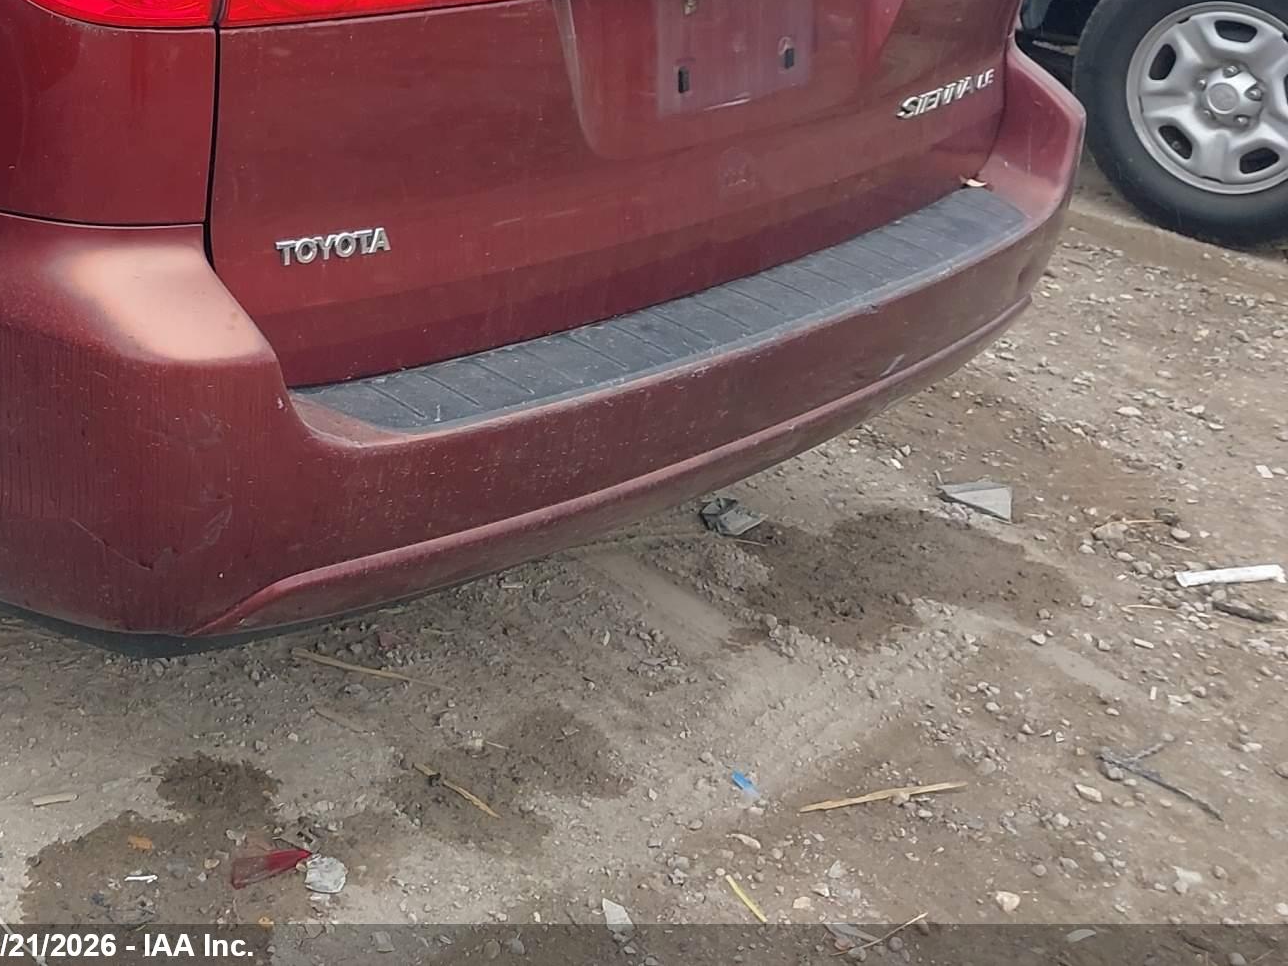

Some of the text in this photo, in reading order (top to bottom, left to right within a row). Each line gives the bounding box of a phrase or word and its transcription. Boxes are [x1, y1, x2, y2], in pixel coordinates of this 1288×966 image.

[896, 68, 995, 119] SIENNA LE
[275, 227, 391, 266] TOYOTA
